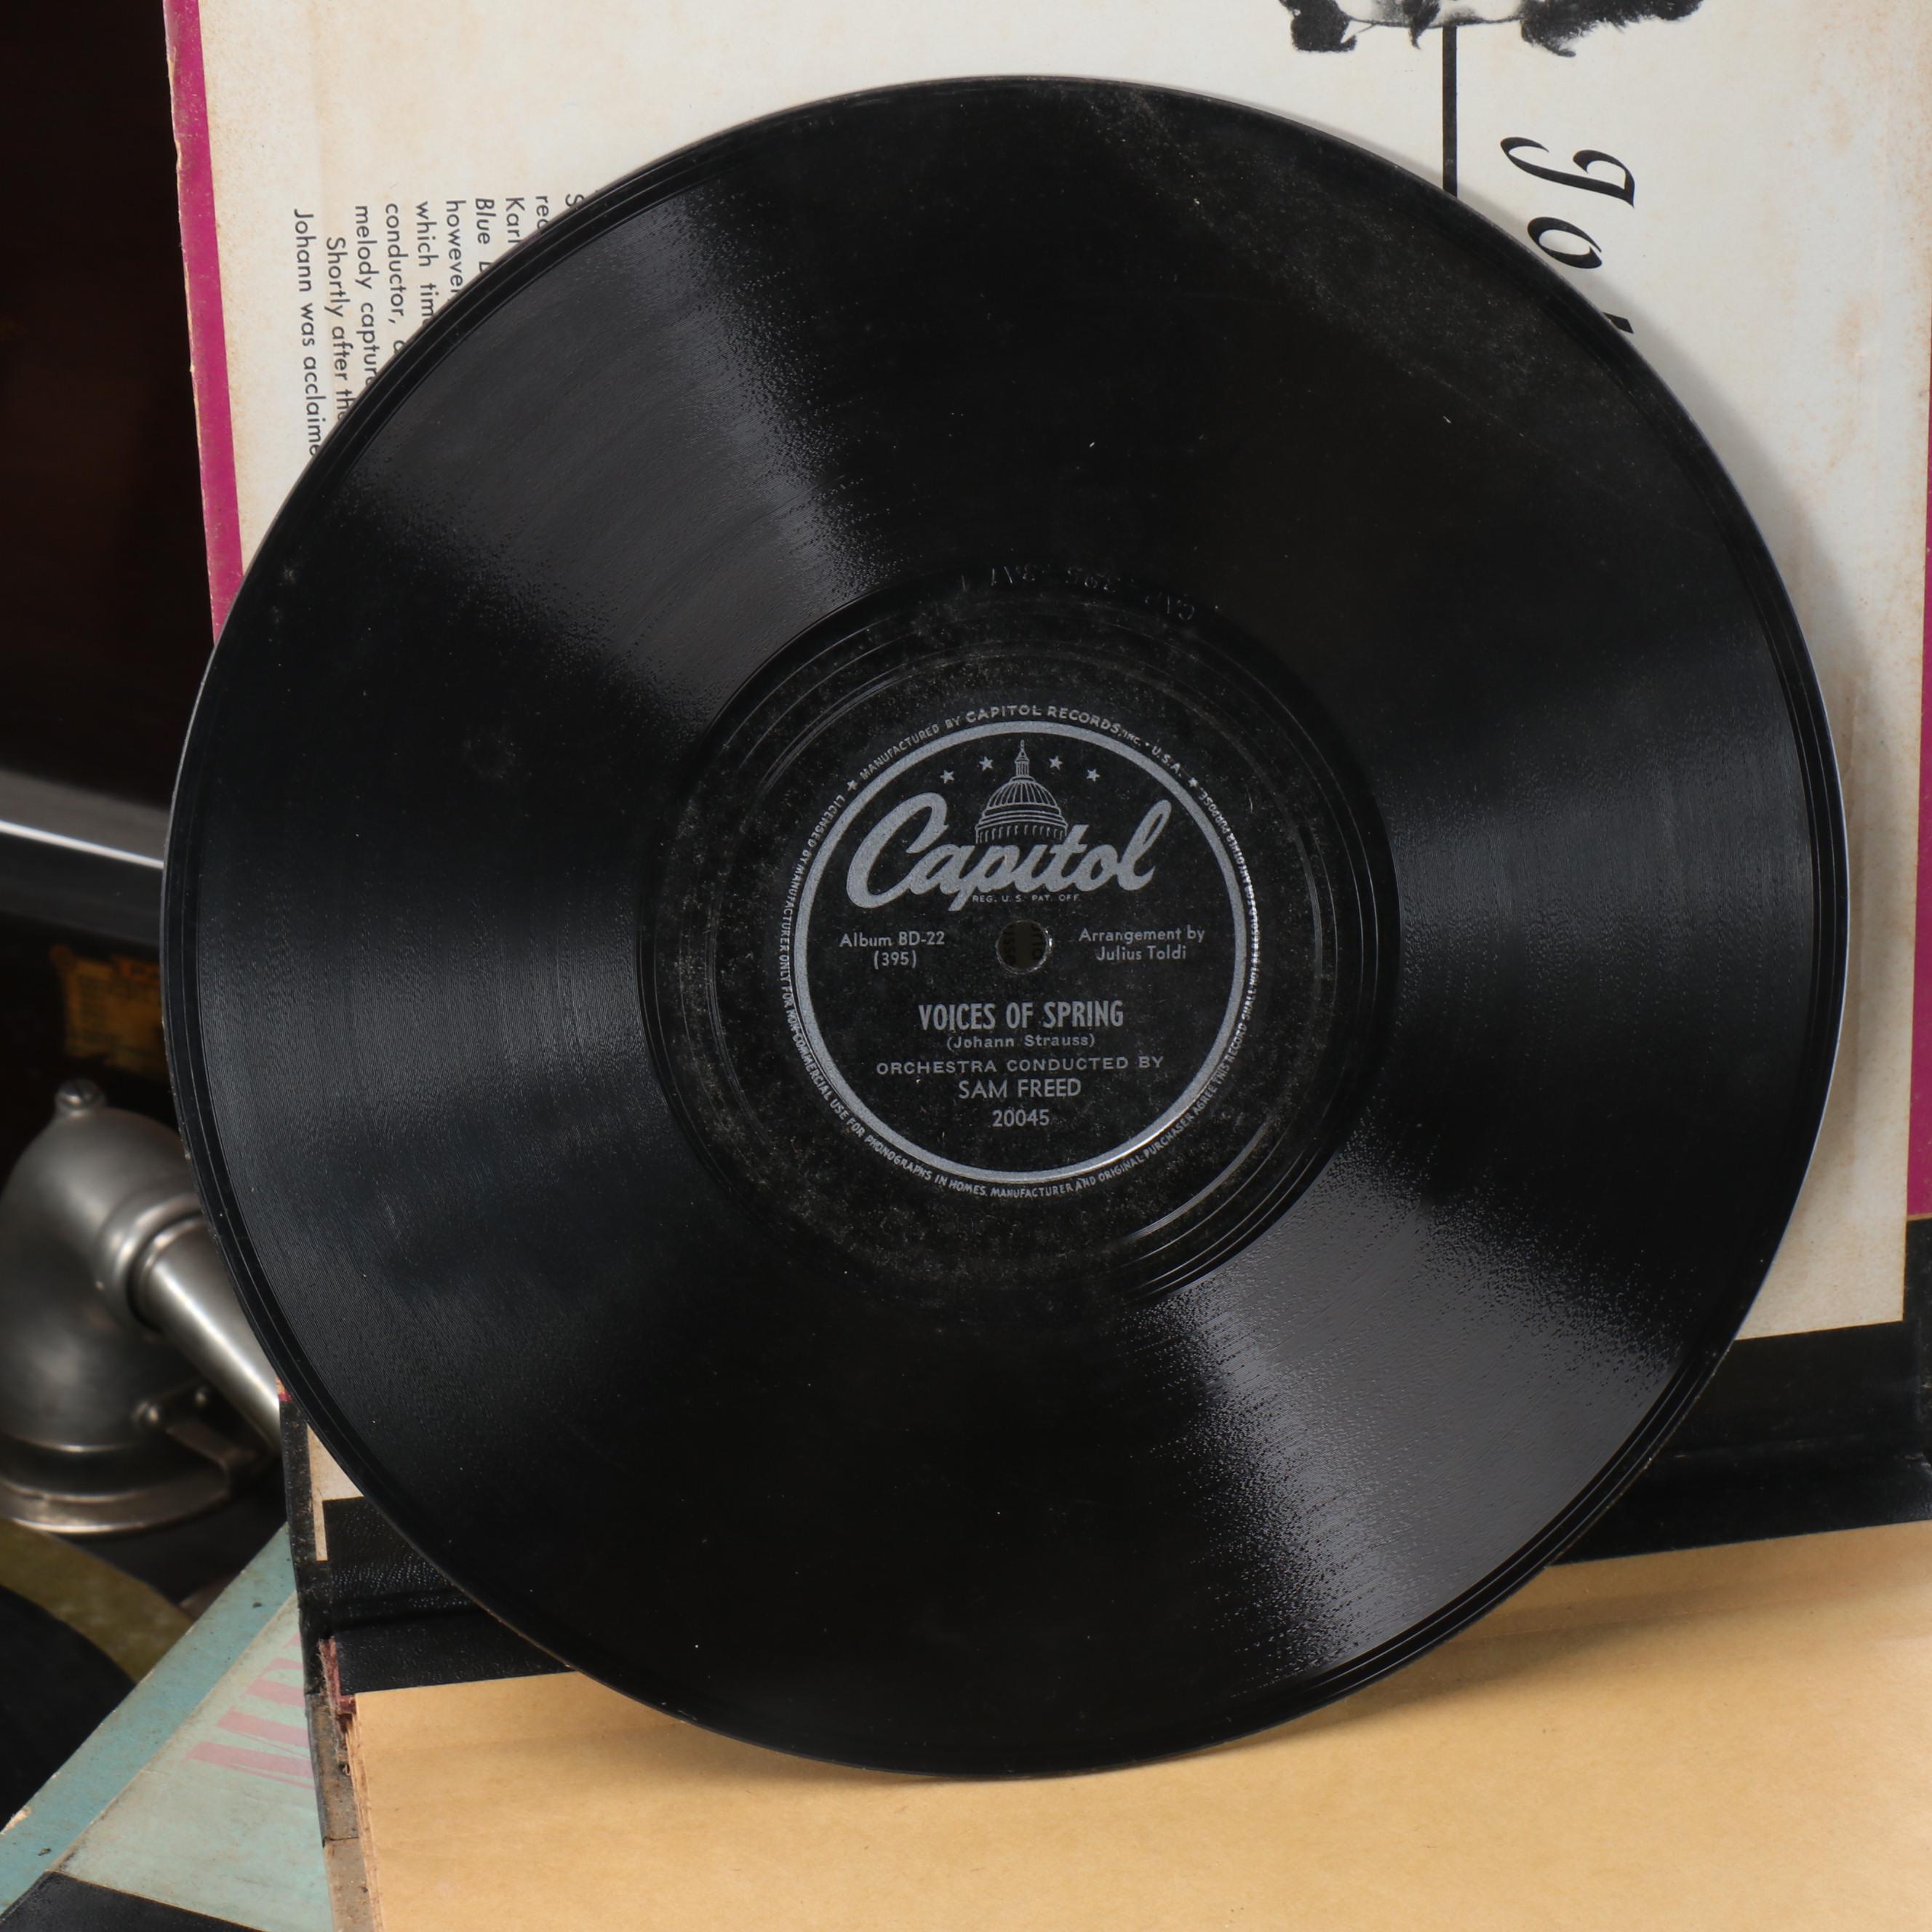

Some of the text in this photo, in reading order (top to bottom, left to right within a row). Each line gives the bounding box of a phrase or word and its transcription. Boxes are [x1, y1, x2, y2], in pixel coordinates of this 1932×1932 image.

[415, 201, 439, 267] which
[476, 198, 497, 245] Blue
[1501, 136, 1635, 334] Jo
[294, 209, 317, 292] Johann
[355, 205, 380, 290] melody
[386, 203, 409, 324] conductor,
[324, 236, 351, 318] Shortly
[300, 303, 315, 346] was
[332, 326, 354, 381] after
[858, 723, 941, 780] MANUFACTURED
[944, 715, 962, 729] BY
[964, 704, 1042, 724] CAPITOL
[805, 793, 847, 848] LICENSED
[847, 792, 1171, 911] Capitol
[779, 862, 805, 952] MANUFACTURER
[973, 895, 997, 903] REG.
[1058, 894, 1080, 902] OFF.
[839, 931, 945, 947] Album BD-22
[1078, 924, 1205, 944] Arrangement by
[778, 954, 791, 982] ONLY
[874, 949, 917, 970] (395)
[1096, 944, 1186, 961] Julius Toldi
[781, 985, 794, 1007] FOR
[918, 999, 1124, 1031] VOICES OF SPRING
[946, 1033, 1095, 1051] (Johann Strauss)
[1223, 1022, 1248, 1063] RECORD
[876, 1055, 1165, 1076] ORCHESTRA CONDUCTED BY
[1210, 1061, 1231, 1086] THIS
[958, 1077, 1082, 1099] SAM FREED
[1189, 1082, 1219, 1116] AGREE
[828, 1098, 850, 1120] USE
[992, 1108, 1050, 1127] 20045
[845, 1116, 866, 1138] FOR
[1141, 1111, 1197, 1159] PURCHASER
[863, 1133, 933, 1181] PHONOGRAPHS
[1096, 1152, 1145, 1182] ORIGINAL
[933, 1173, 949, 1187] IN
[990, 1181, 1077, 1199] MANUFACTURER
